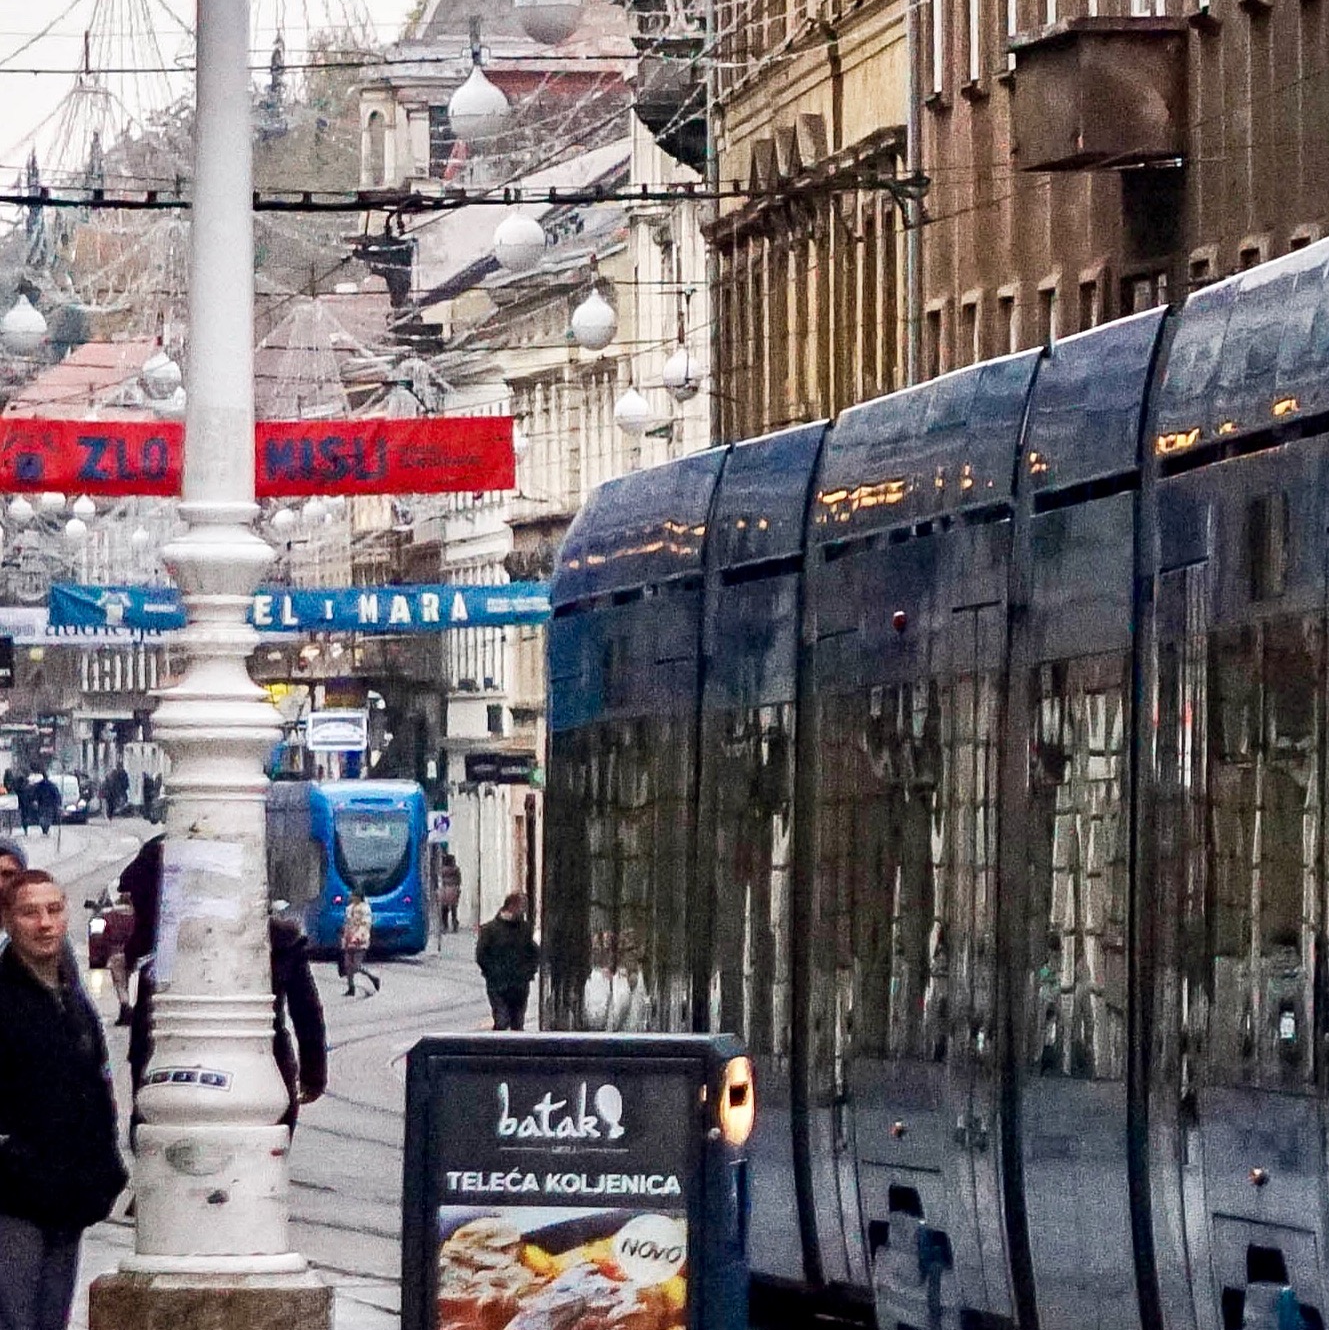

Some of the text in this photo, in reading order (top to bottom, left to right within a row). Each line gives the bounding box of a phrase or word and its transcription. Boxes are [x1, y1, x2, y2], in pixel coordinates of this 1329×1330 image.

[77, 436, 168, 482] ZLO
[358, 591, 469, 624] MARA
[498, 1081, 601, 1138] batak
[446, 1166, 681, 1195] TELEĆA KOLJENICA
